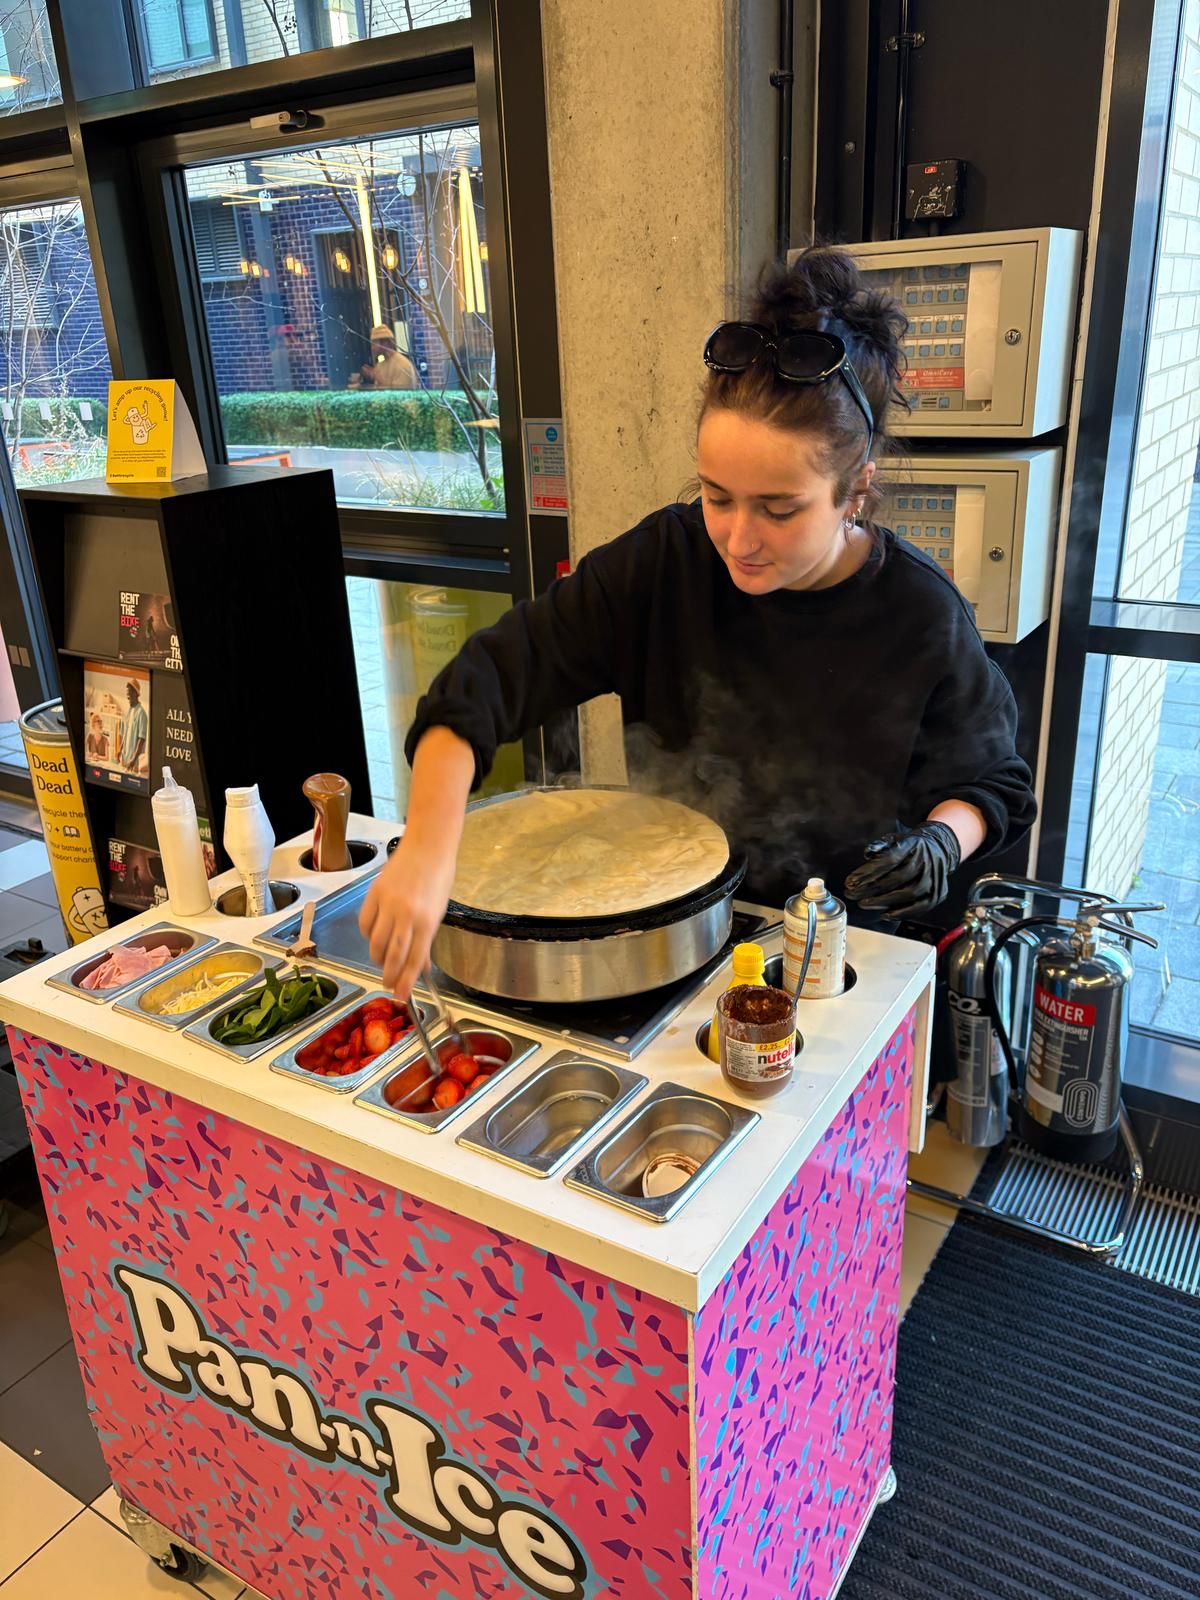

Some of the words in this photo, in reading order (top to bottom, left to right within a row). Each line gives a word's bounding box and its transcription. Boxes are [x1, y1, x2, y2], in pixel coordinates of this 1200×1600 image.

[120, 591, 140, 605] RENT
[120, 604, 135, 616] THE
[170, 646, 182, 659] TH
[166, 708, 186, 723] ALL
[166, 727, 194, 743] NEED
[166, 745, 192, 762] LOVE
[31, 752, 69, 773] Dead
[36, 775, 74, 795] Dead
[109, 841, 126, 854] RENT
[110, 851, 123, 863] THE
[1040, 992, 1085, 1022] WATER
[115, 1265, 582, 1596] Pan-n-Ice
